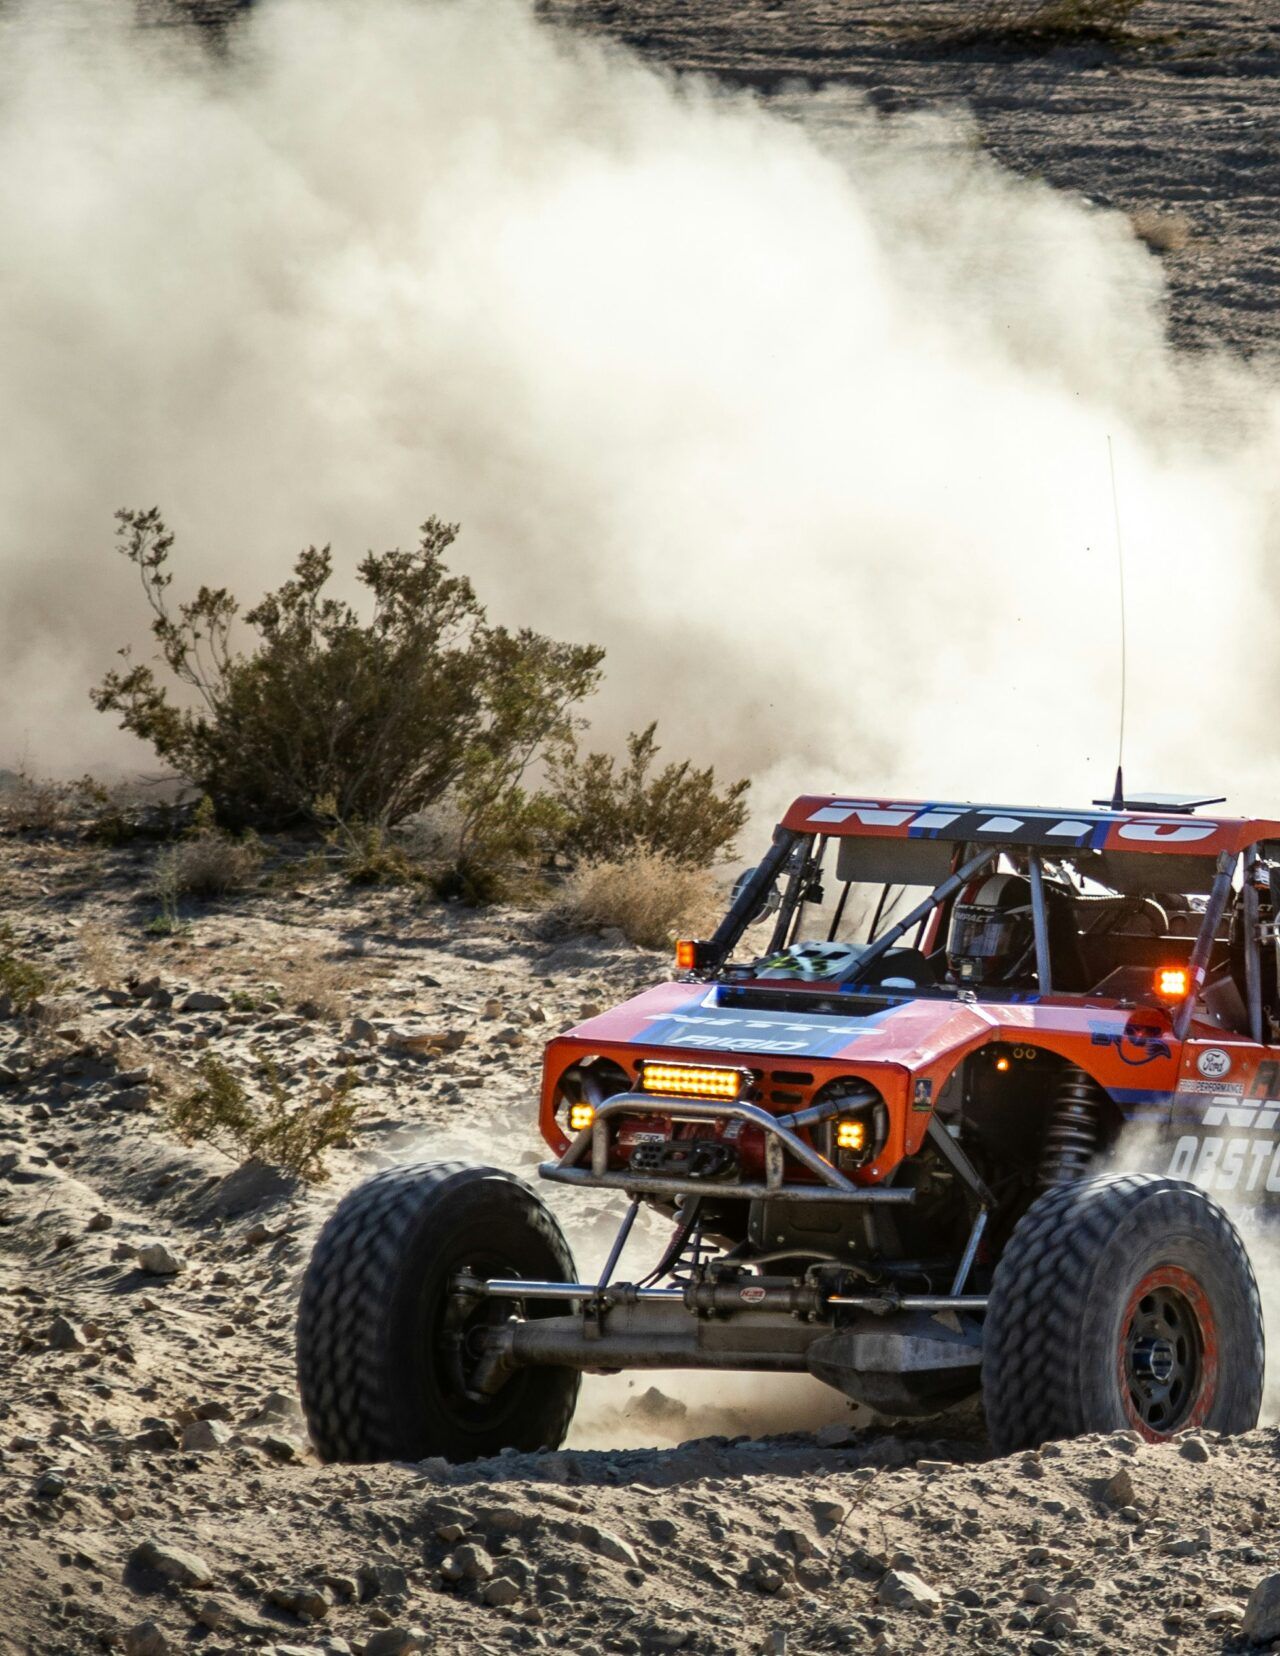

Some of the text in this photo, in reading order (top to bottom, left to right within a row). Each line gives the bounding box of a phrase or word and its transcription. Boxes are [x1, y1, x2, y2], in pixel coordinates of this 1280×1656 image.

[807, 801, 1220, 842] NITTO
[643, 1013, 887, 1035] NITTO
[669, 1034, 810, 1051] RIGID
[1201, 1051, 1227, 1074] Ford
[1196, 1081, 1243, 1095] PERFORMANCE
